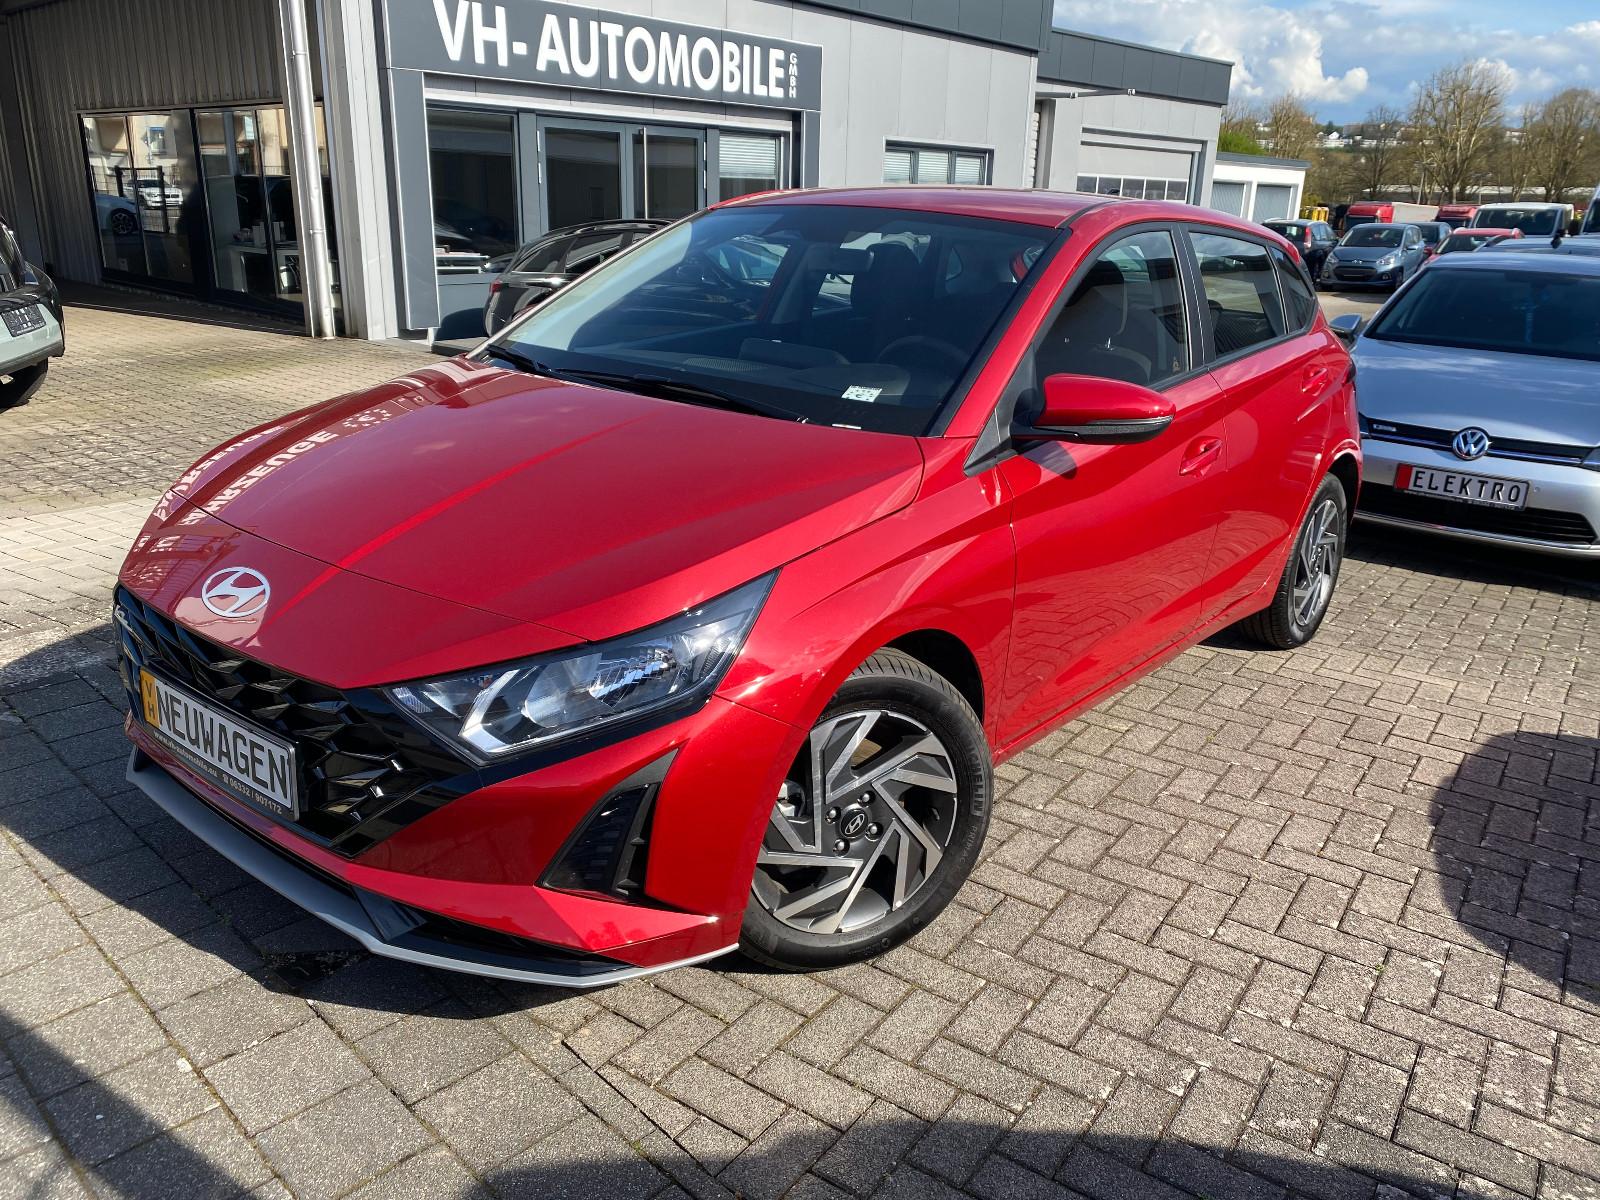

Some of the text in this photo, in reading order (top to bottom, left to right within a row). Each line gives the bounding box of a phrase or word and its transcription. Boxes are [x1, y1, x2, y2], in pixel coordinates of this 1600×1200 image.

[535, 13, 785, 98] AUTOMOBILE
[788, 52, 798, 98] GMBH
[1412, 470, 1521, 503] ELEKTRO
[155, 685, 288, 800] NEUWAGEN
